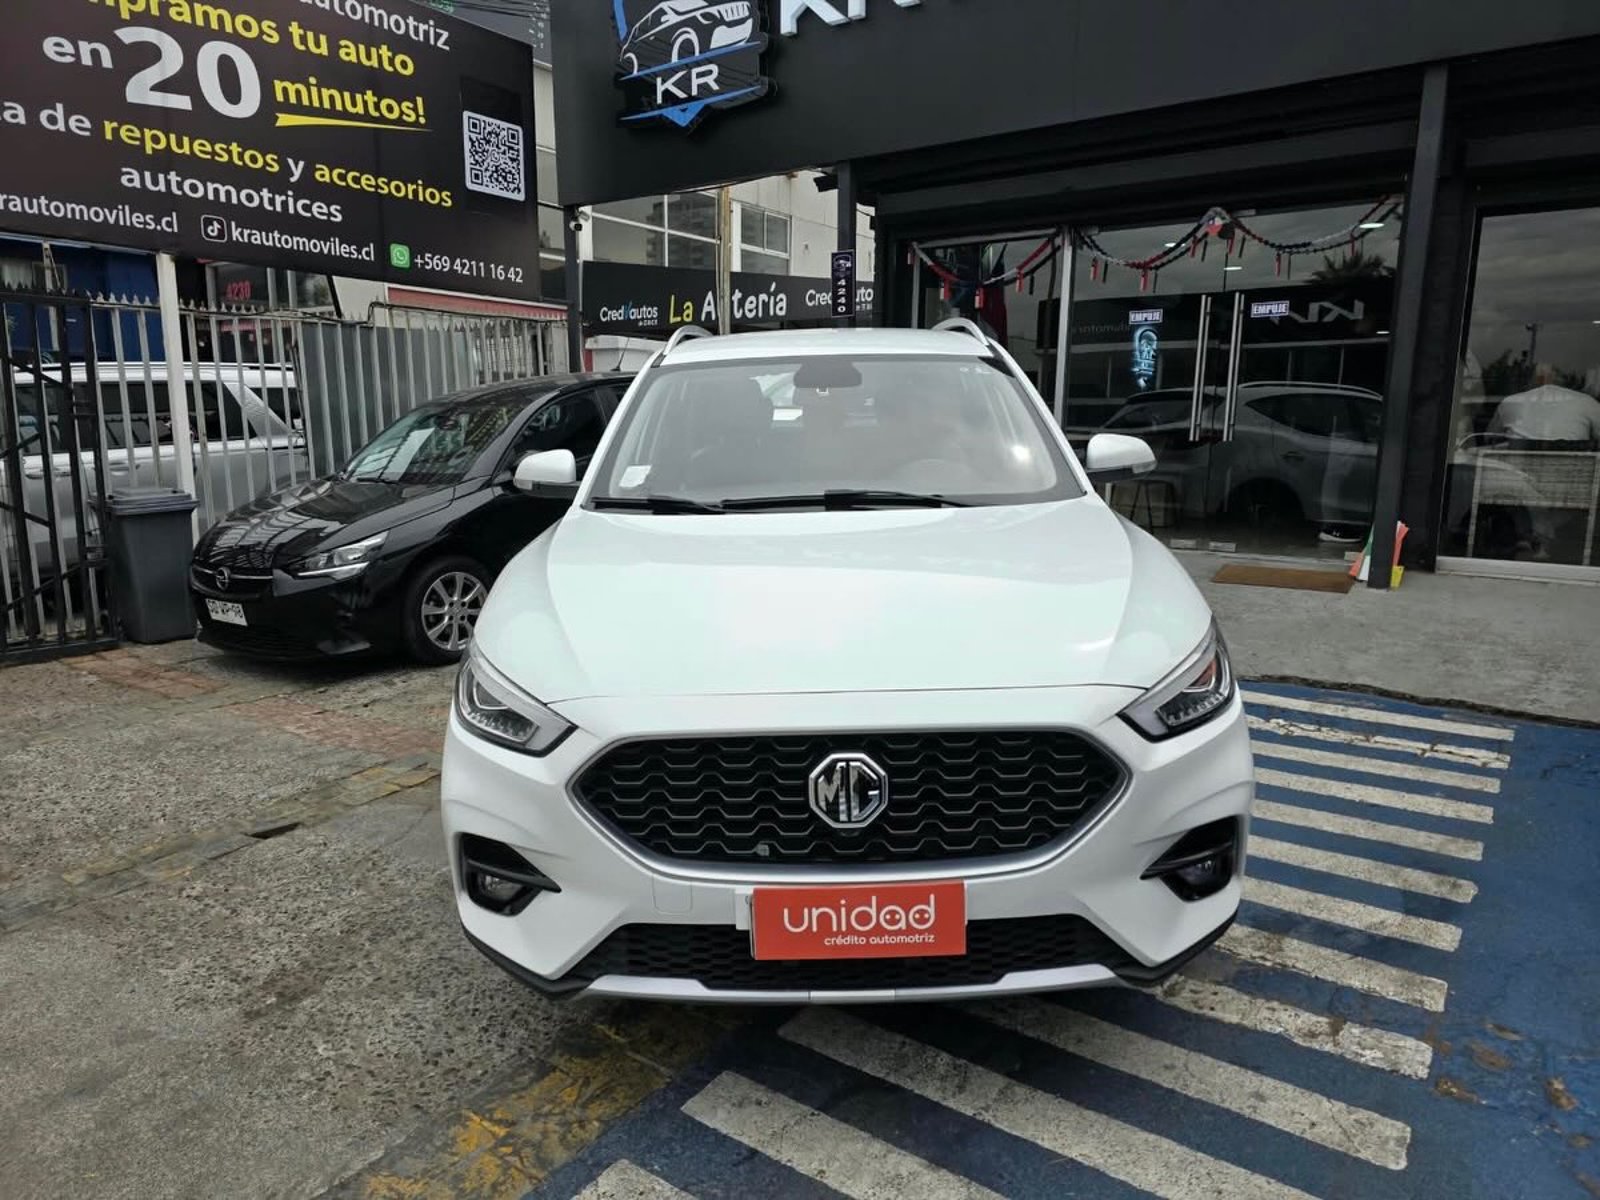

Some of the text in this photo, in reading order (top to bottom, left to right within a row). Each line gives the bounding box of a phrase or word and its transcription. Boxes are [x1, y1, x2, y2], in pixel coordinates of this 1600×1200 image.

[88, 0, 414, 76] pramos tu auto
[300, 0, 450, 51] utomotriz
[42, 26, 427, 125] en 20 minutos!
[656, 64, 721, 105] KR
[0, 101, 453, 208] a de repuestos y accesorios
[120, 167, 343, 222] automotrices
[231, 221, 375, 261] krautomoviles.cl
[414, 253, 523, 283] +569 4211 16 42
[669, 281, 787, 324] La Atería
[817, 761, 880, 823] MG
[783, 894, 935, 933] unidad
[824, 934, 935, 946] crédito automotriz
